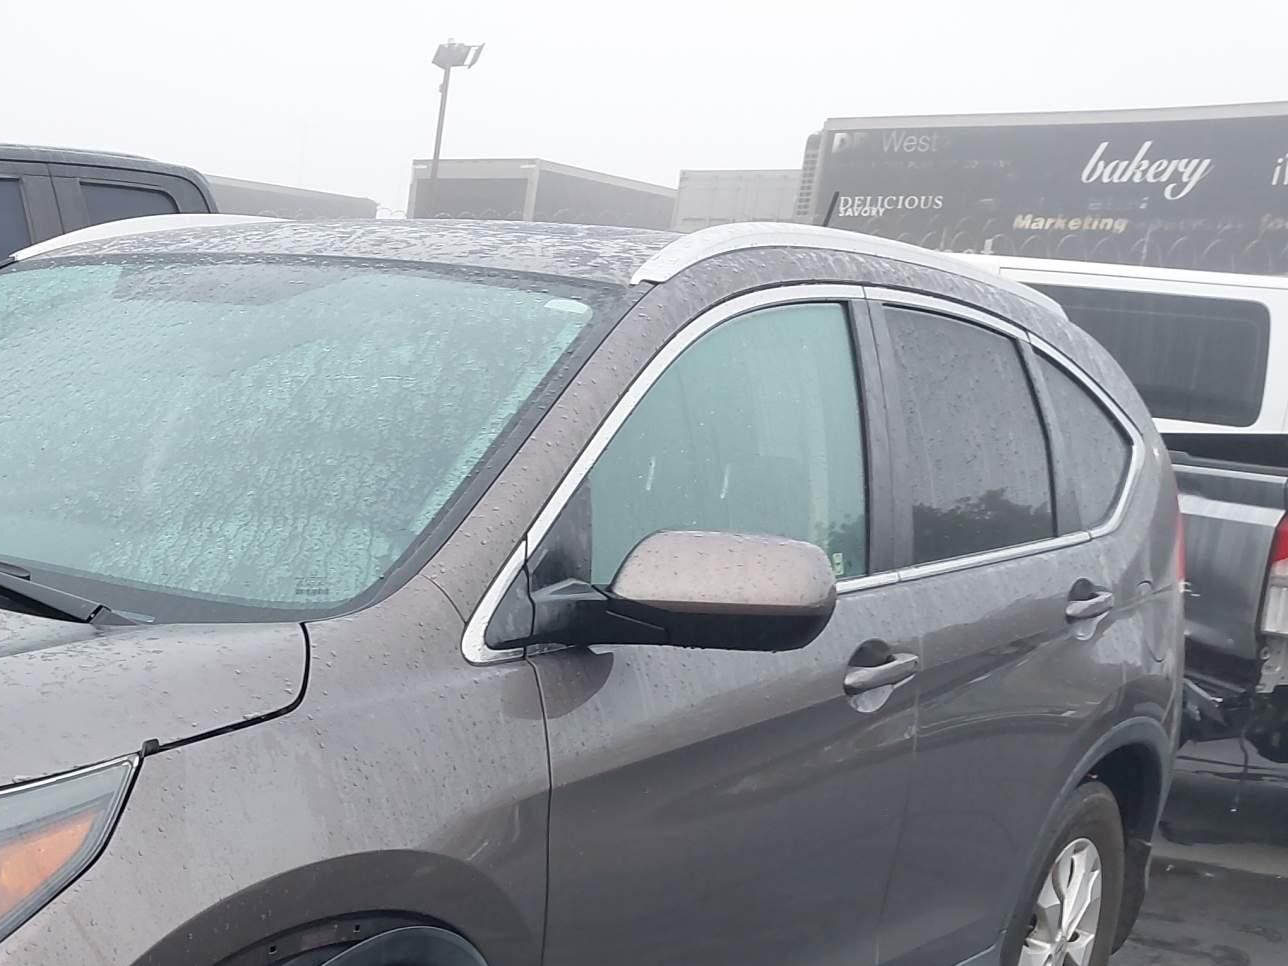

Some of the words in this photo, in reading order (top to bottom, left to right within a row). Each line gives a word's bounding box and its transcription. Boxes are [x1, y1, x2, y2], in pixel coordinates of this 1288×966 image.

[883, 131, 937, 153] West
[1080, 140, 1213, 201] bakery
[838, 207, 885, 217] SAVORY
[839, 195, 944, 210] DELICIOUS
[1013, 213, 1129, 233] Marketing
